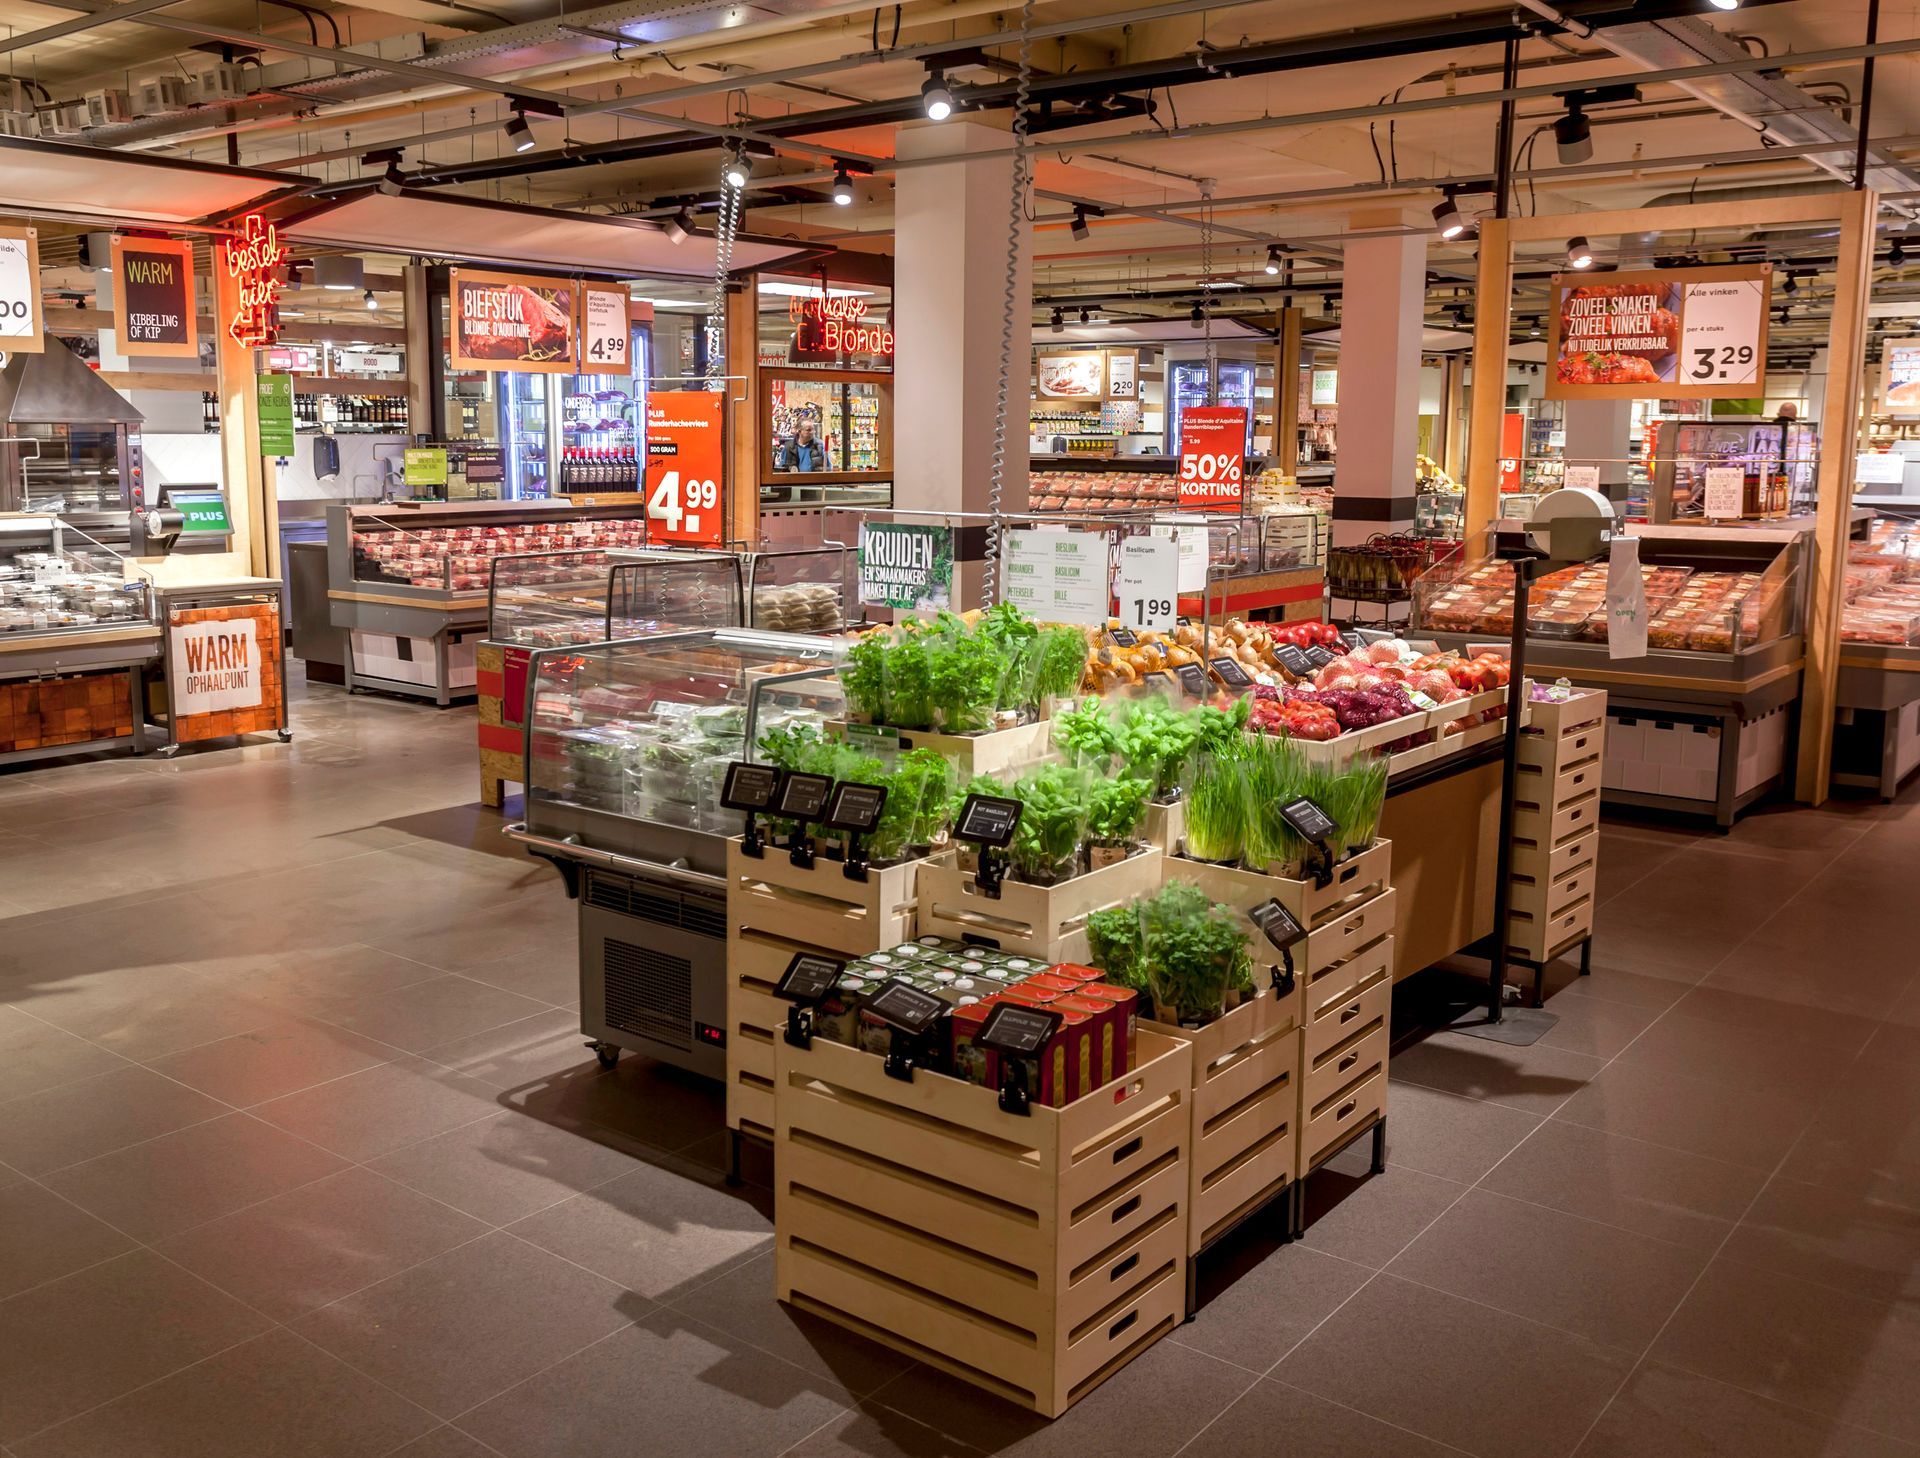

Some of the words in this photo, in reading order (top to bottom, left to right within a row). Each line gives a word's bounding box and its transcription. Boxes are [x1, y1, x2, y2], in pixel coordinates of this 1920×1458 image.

[226, 223, 282, 278] bestel
[127, 260, 174, 285] WARM
[239, 275, 280, 311] hier
[1689, 288, 1707, 298] Alle
[1709, 287, 1739, 297] vinken
[463, 288, 525, 322] BIEFSTUK
[1569, 298, 1609, 317] ZOVEEL
[1611, 294, 1660, 317] SMAKEN,
[130, 313, 179, 328] KIBBELING
[130, 325, 143, 338] OF
[145, 326, 162, 339] KIP
[464, 319, 491, 336] BLONDE
[492, 321, 532, 338] D'AQUITAINE
[1568, 316, 1608, 337] ZOVEEL
[1610, 315, 1655, 335] VINKEN.
[824, 320, 894, 354] Blonde
[1567, 339, 1579, 352] NU
[1691, 345, 1754, 379] 3.29
[1181, 453, 1241, 481] 50%
[1181, 481, 1241, 497] KORTING
[647, 470, 717, 533] 4.99
[190, 511, 225, 522] PLUS
[864, 530, 934, 570] KRUIDEN
[864, 565, 875, 582] EN
[875, 567, 927, 586] SMAAKMAKERS
[1054, 566, 1081, 578] BASILICUM
[864, 581, 888, 601] MAKEN
[889, 583, 903, 601] HET
[904, 585, 915, 602] AF.
[1134, 599, 1172, 627] 1.99
[185, 633, 248, 673] WARM
[186, 670, 249, 695] OPHAALPUNT
